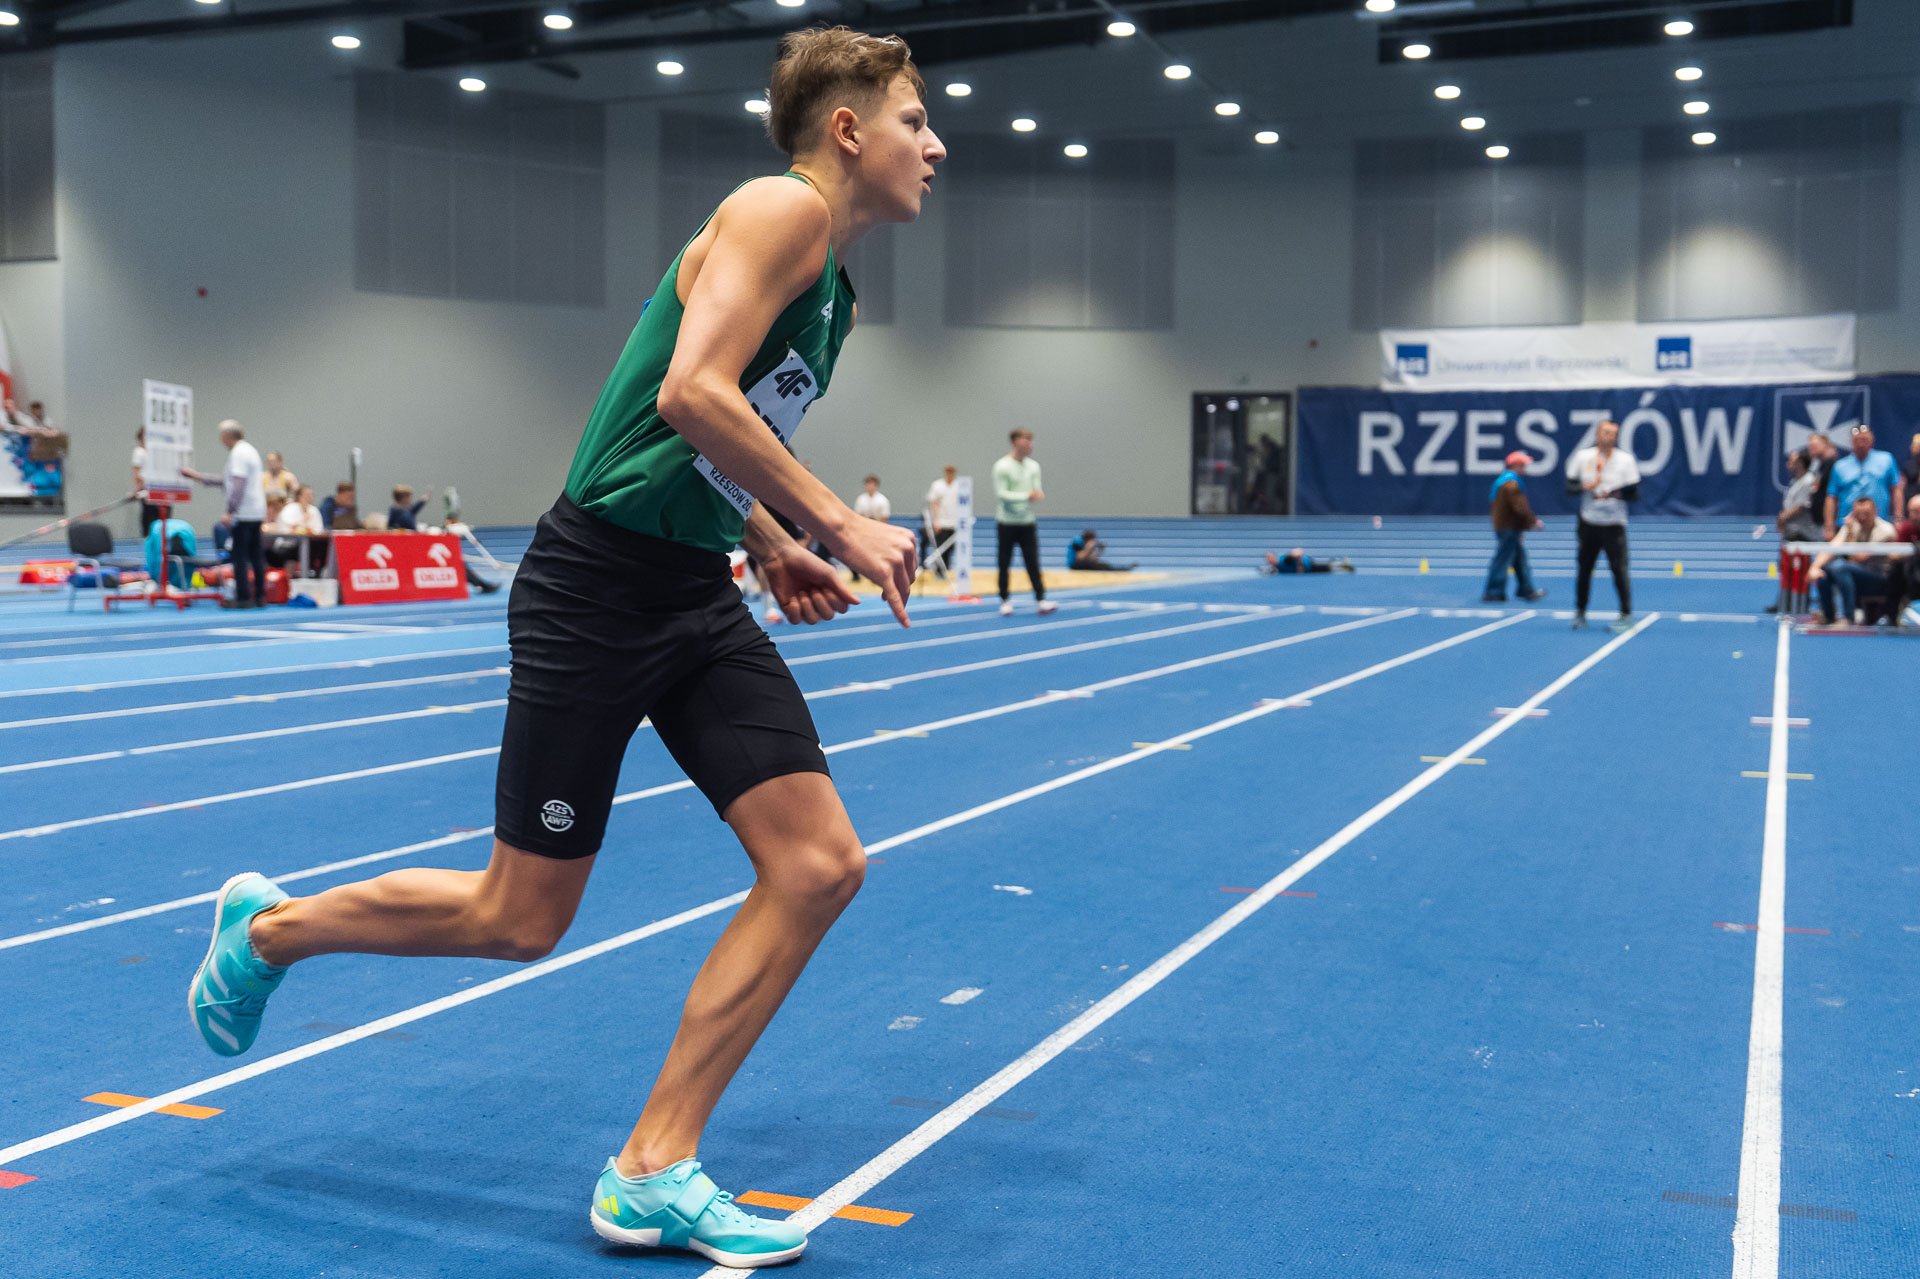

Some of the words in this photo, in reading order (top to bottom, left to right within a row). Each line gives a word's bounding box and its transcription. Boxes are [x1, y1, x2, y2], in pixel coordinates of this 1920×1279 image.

[709, 466, 746, 505] RZESZOW
[549, 803, 569, 815] AZS
[545, 815, 568, 827] AWF
